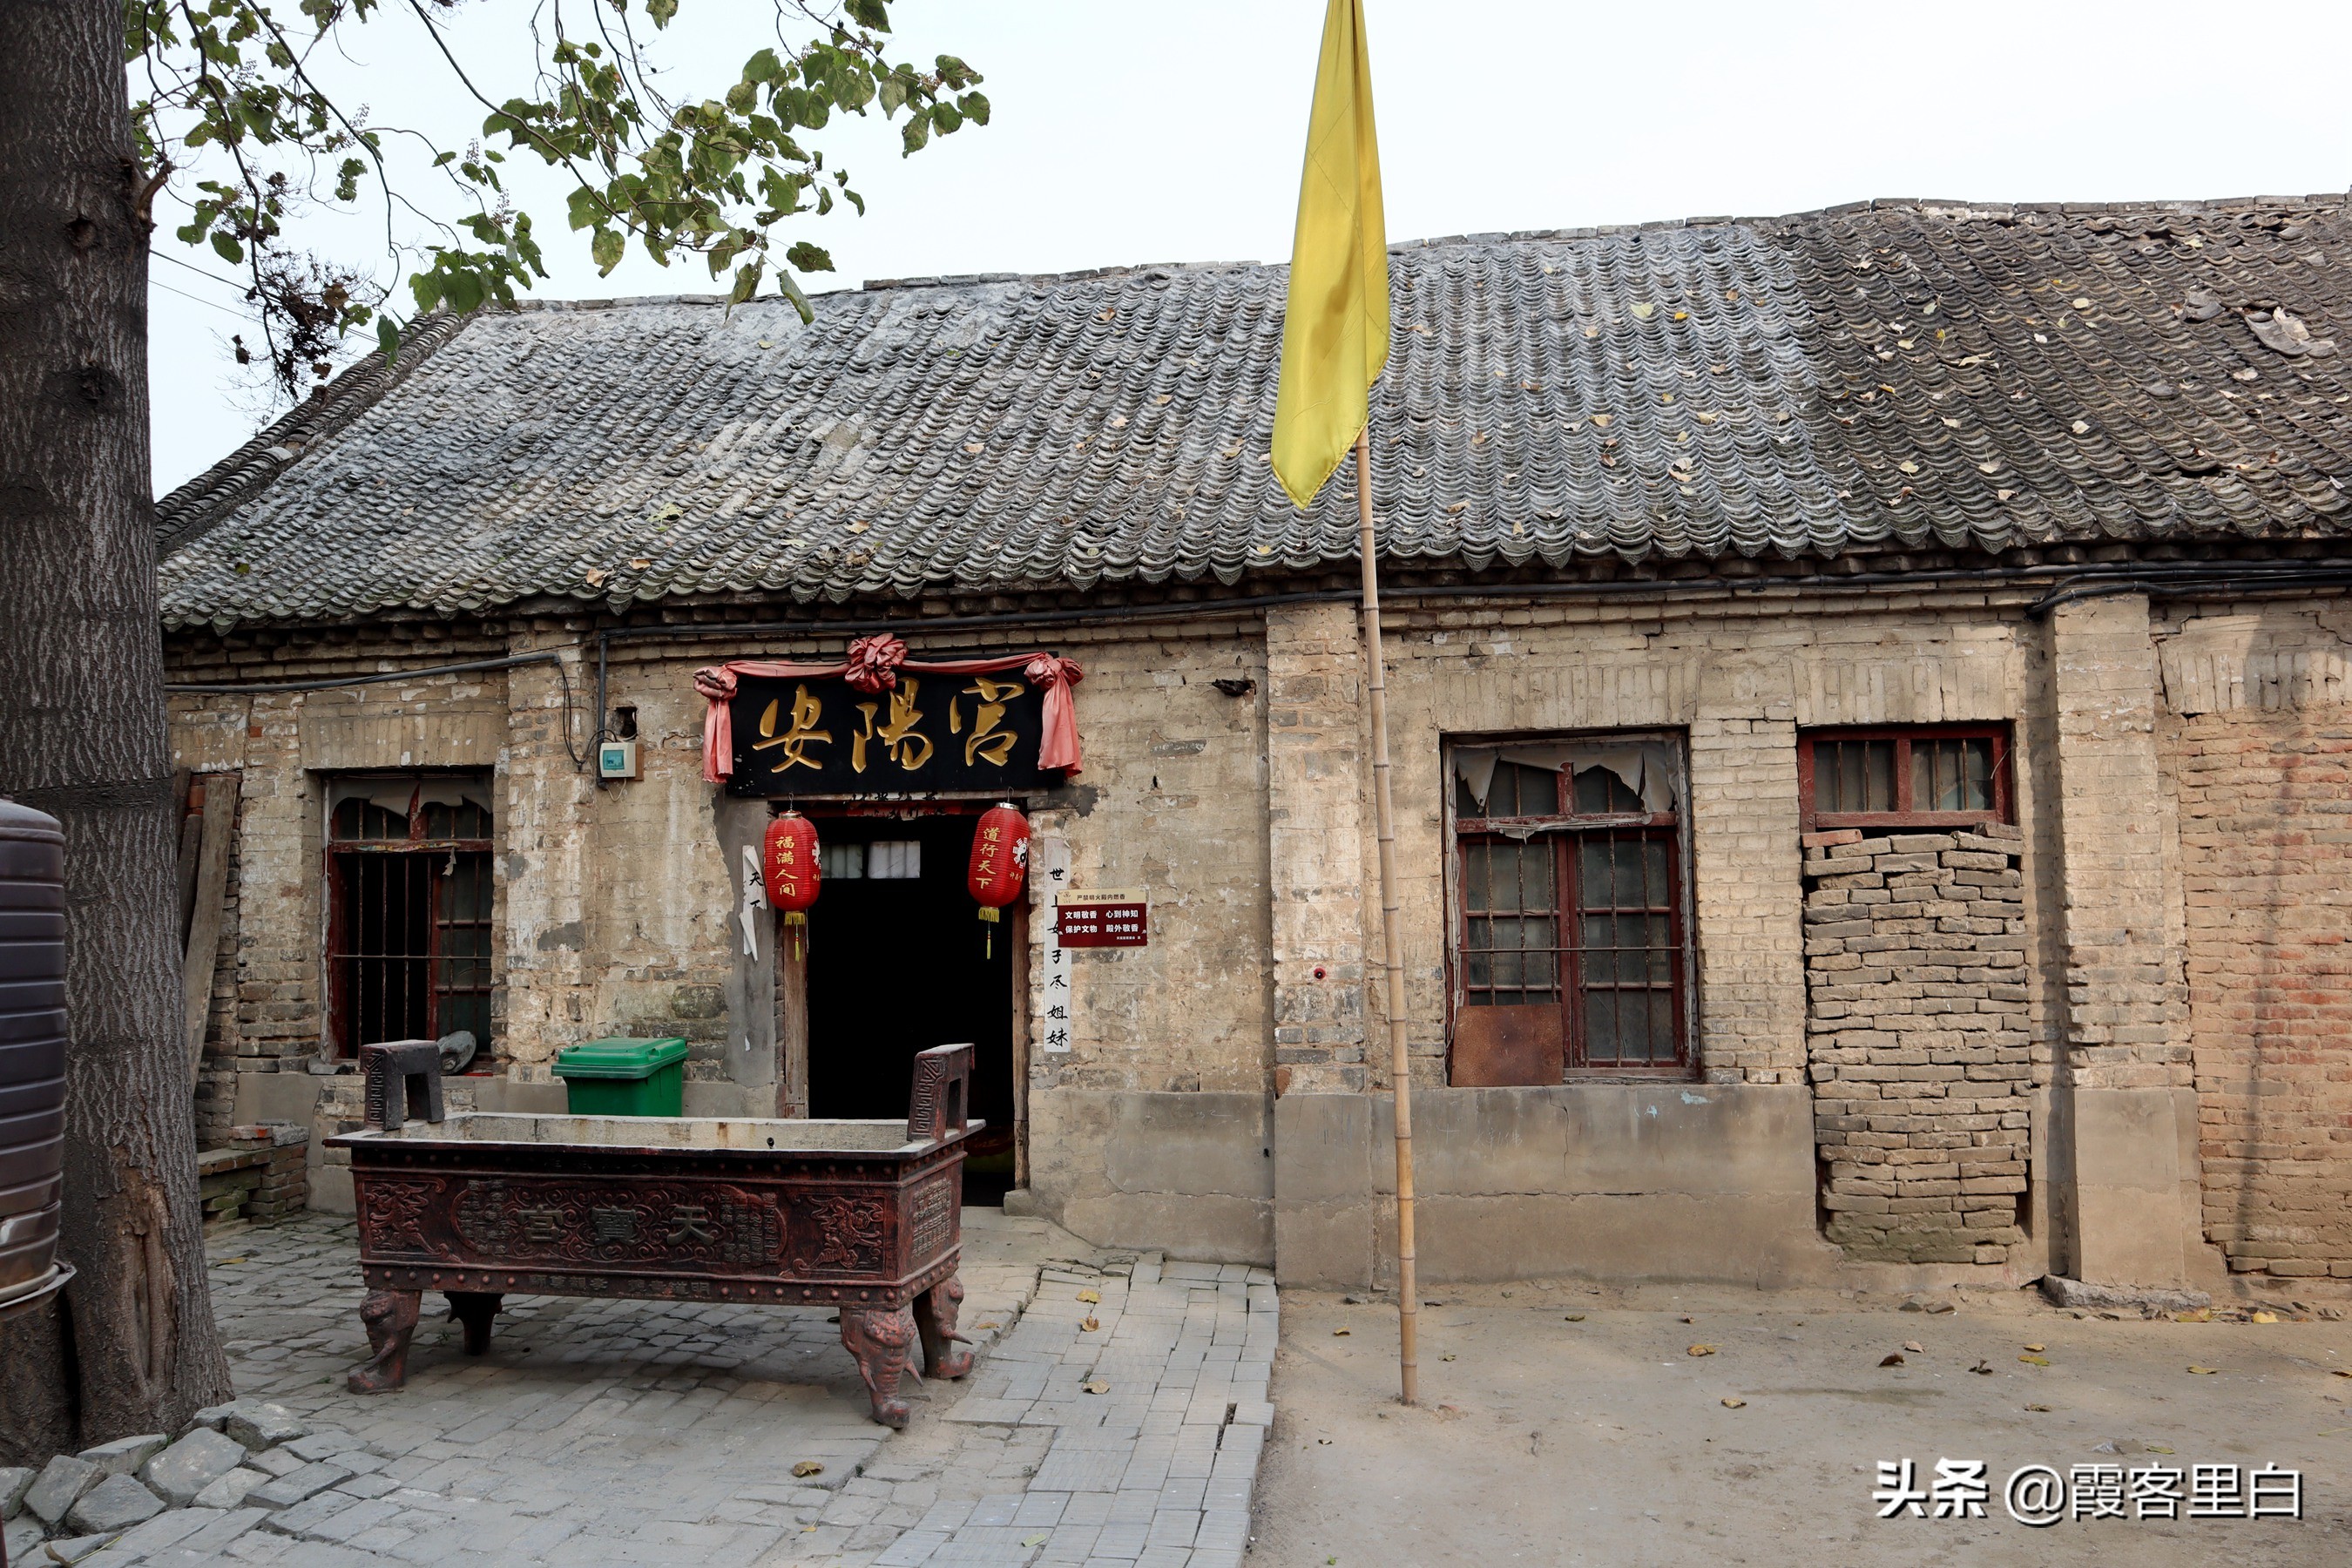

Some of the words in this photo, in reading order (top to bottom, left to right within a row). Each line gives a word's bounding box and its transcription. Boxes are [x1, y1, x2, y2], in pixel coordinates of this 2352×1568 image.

[774, 835, 799, 897] 福满人间
[975, 825, 1002, 889] 道行天下
[1064, 910, 1098, 920] 文明敬香
[1105, 909, 1139, 918] 心到神知
[1064, 925, 1098, 934] 保护文物
[1105, 923, 1139, 933] 殿外敬香
